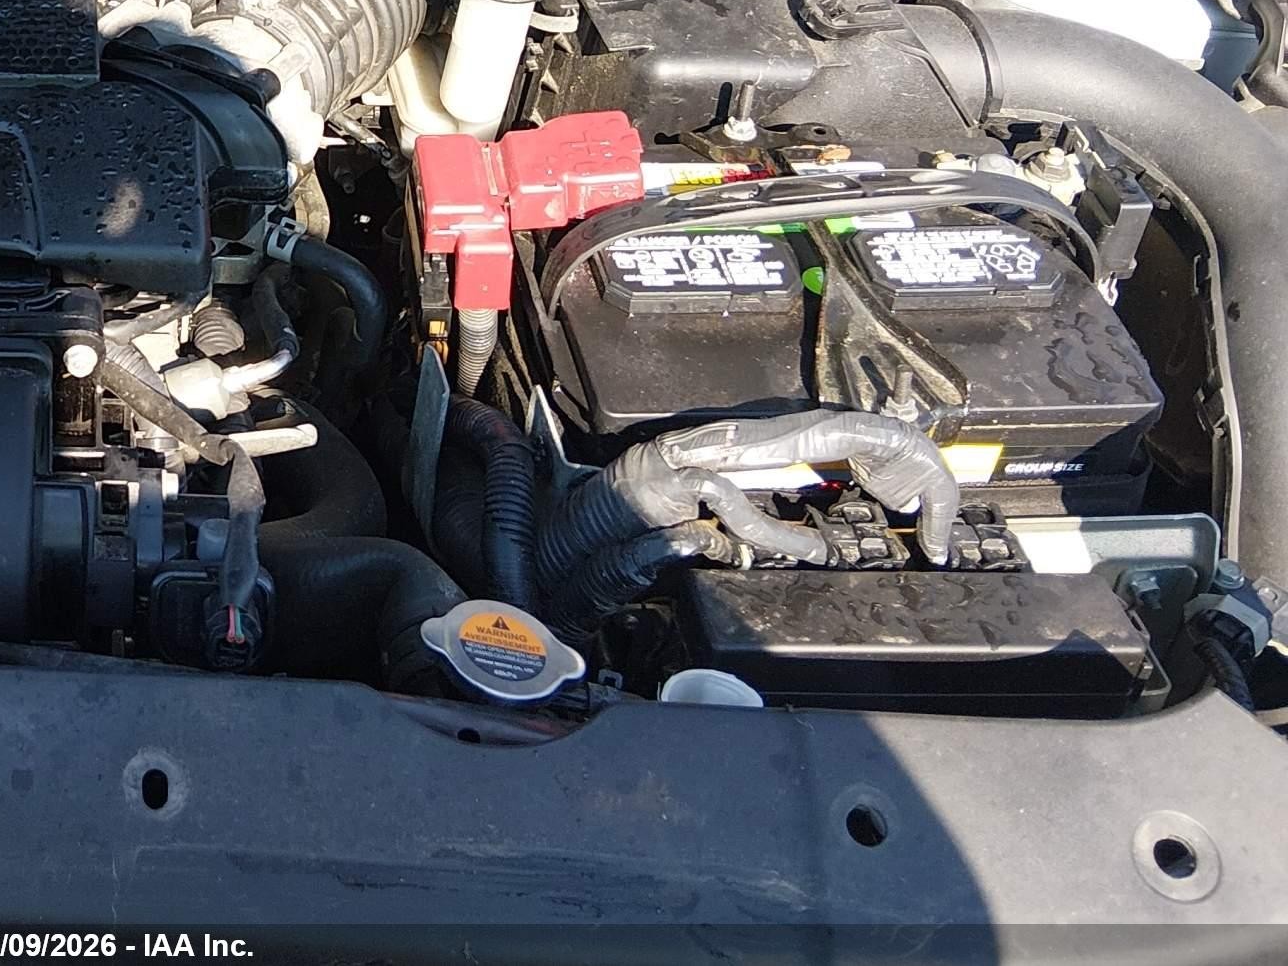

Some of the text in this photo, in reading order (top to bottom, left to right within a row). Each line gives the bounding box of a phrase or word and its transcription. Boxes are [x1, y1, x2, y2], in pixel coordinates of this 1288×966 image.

[1005, 461, 1085, 474] GROUP SIZE
[464, 632, 541, 653] AVERTISSEMENT
[476, 626, 528, 643] WARNING
